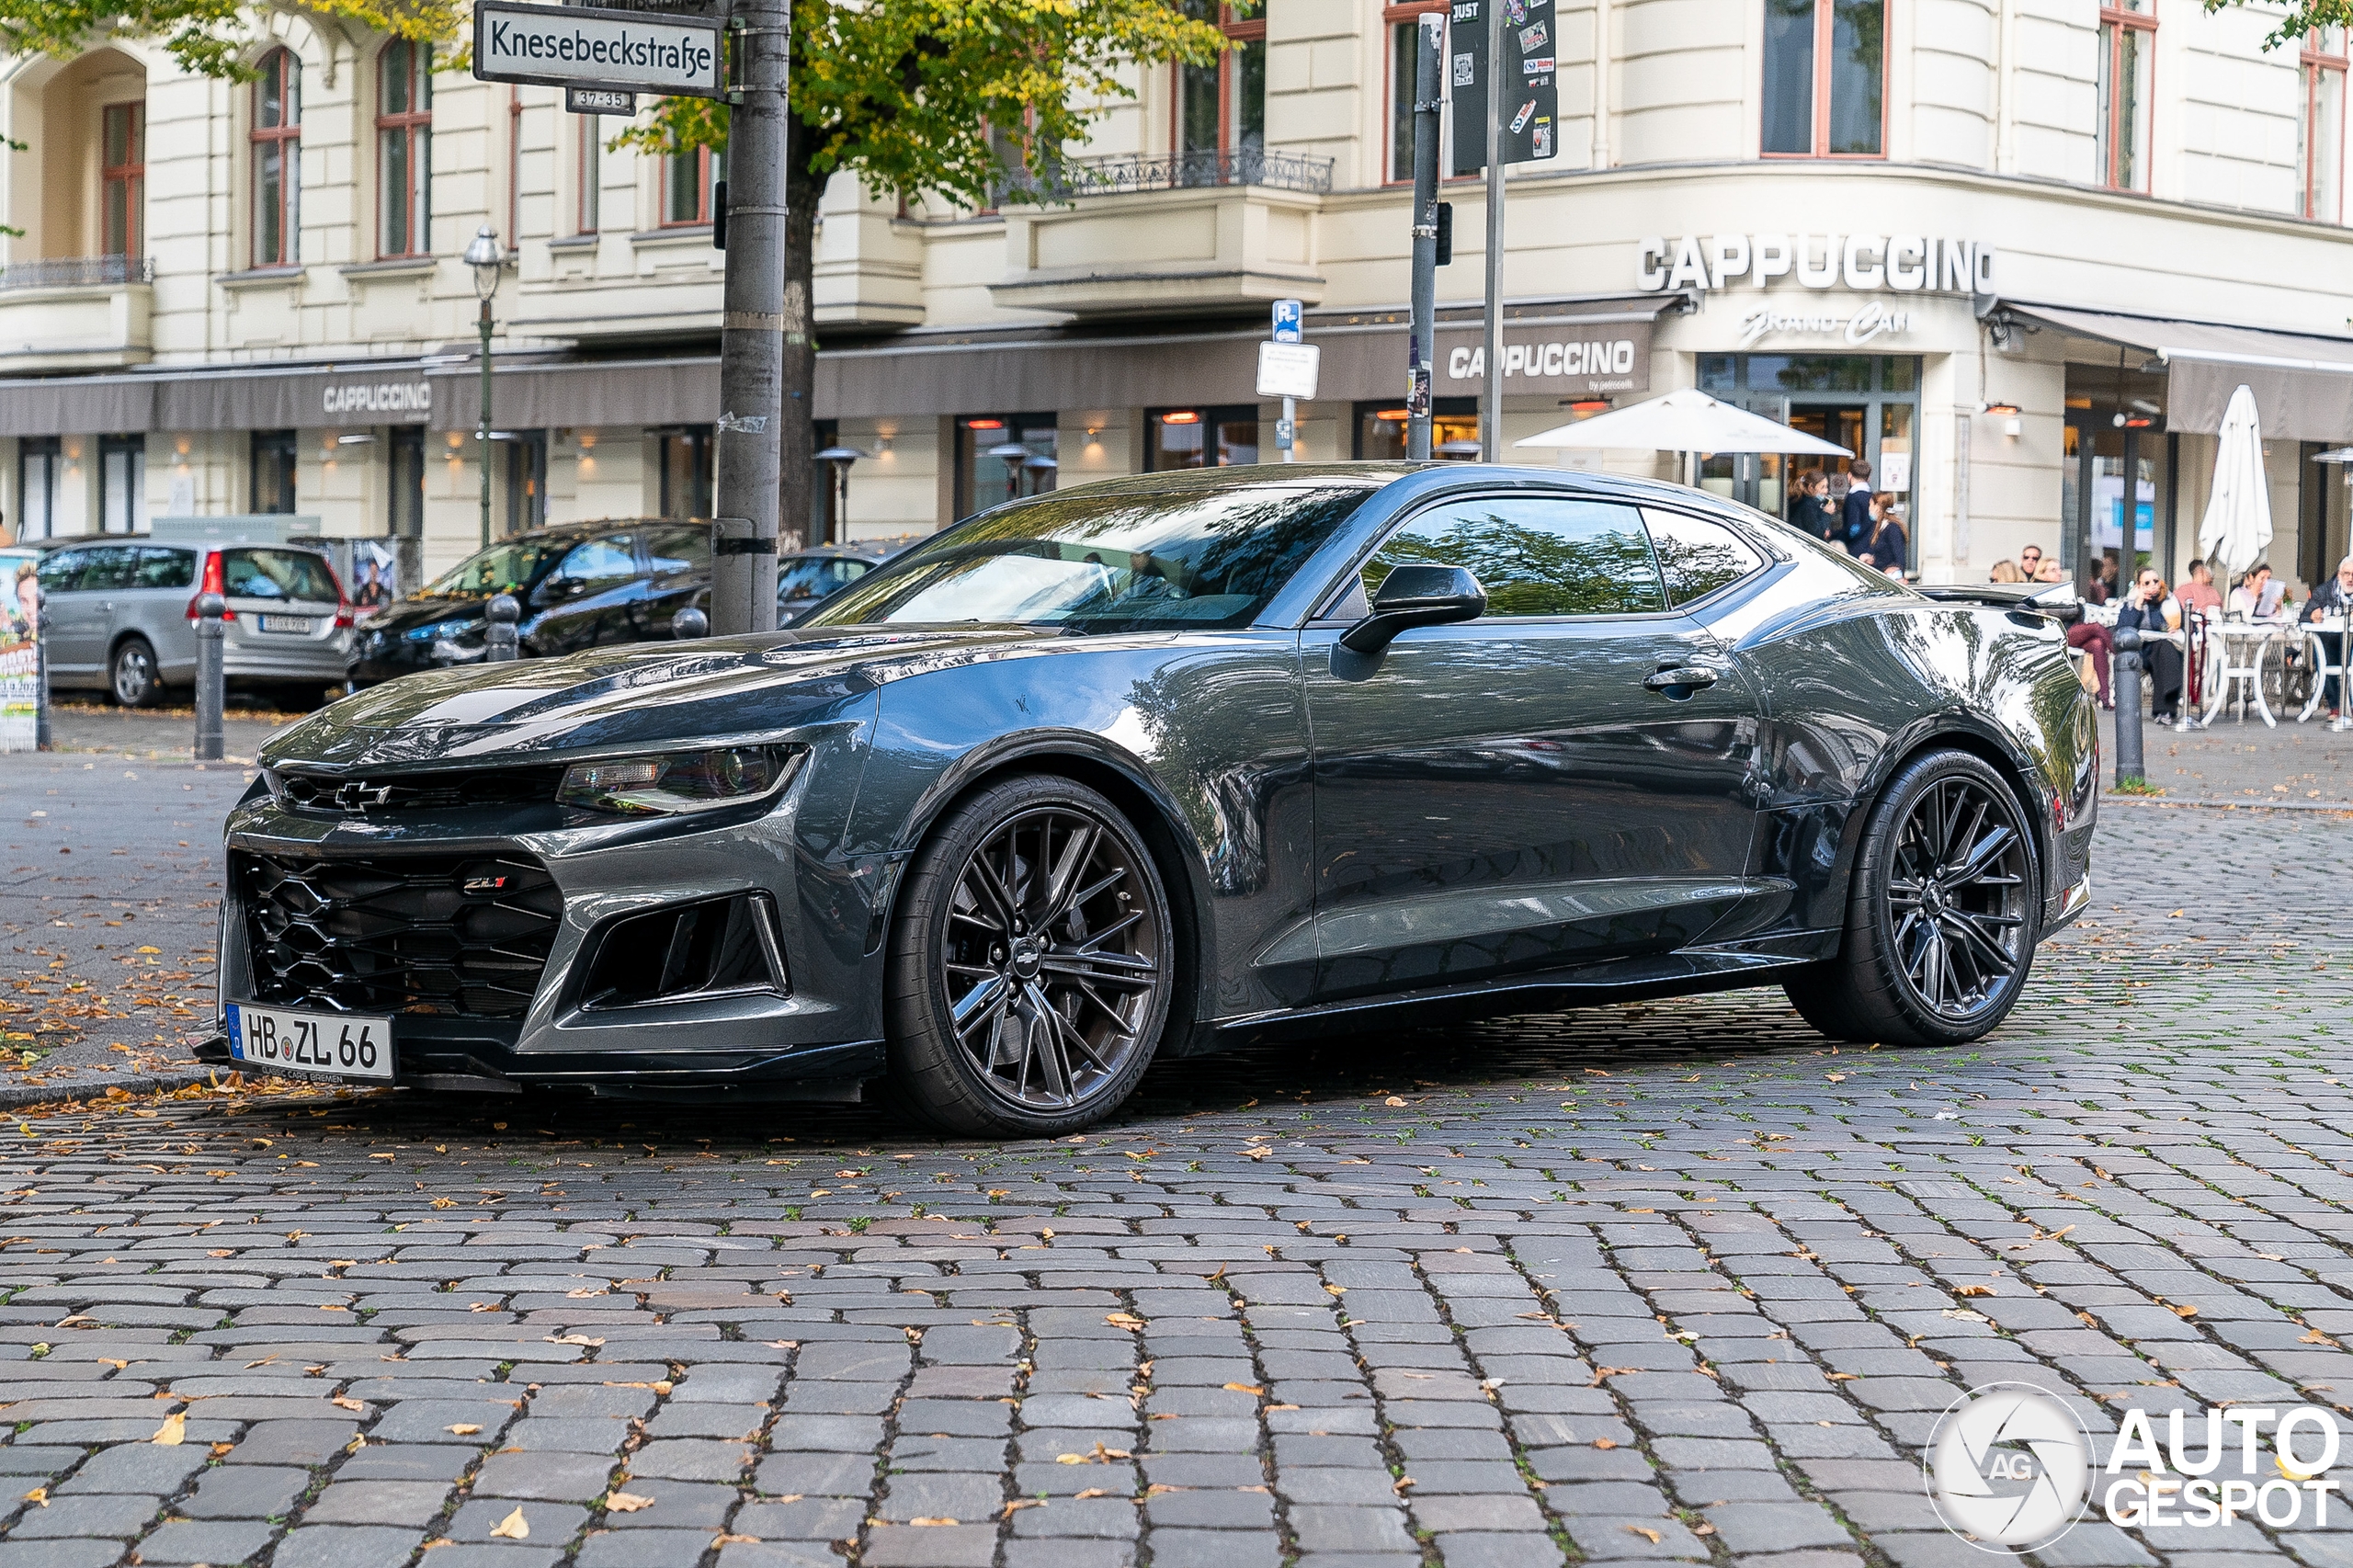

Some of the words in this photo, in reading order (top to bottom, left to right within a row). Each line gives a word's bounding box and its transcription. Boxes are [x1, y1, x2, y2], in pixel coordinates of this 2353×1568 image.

[1453, 2, 1479, 19] JUST
[491, 19, 711, 78] Knesebeckstraße
[579, 91, 622, 107] 37-35
[1636, 233, 1996, 292] CAPPUCCINO
[1448, 339, 1635, 380] CAPUCCINO
[323, 381, 432, 413] CAPPUCCINO
[463, 876, 506, 889] ZL1
[234, 1036, 240, 1050] D
[247, 1014, 278, 1060] HB
[293, 1020, 332, 1066] ZL
[338, 1024, 378, 1069] 66
[287, 1071, 308, 1081] CARS
[310, 1074, 344, 1085] BREMEN
